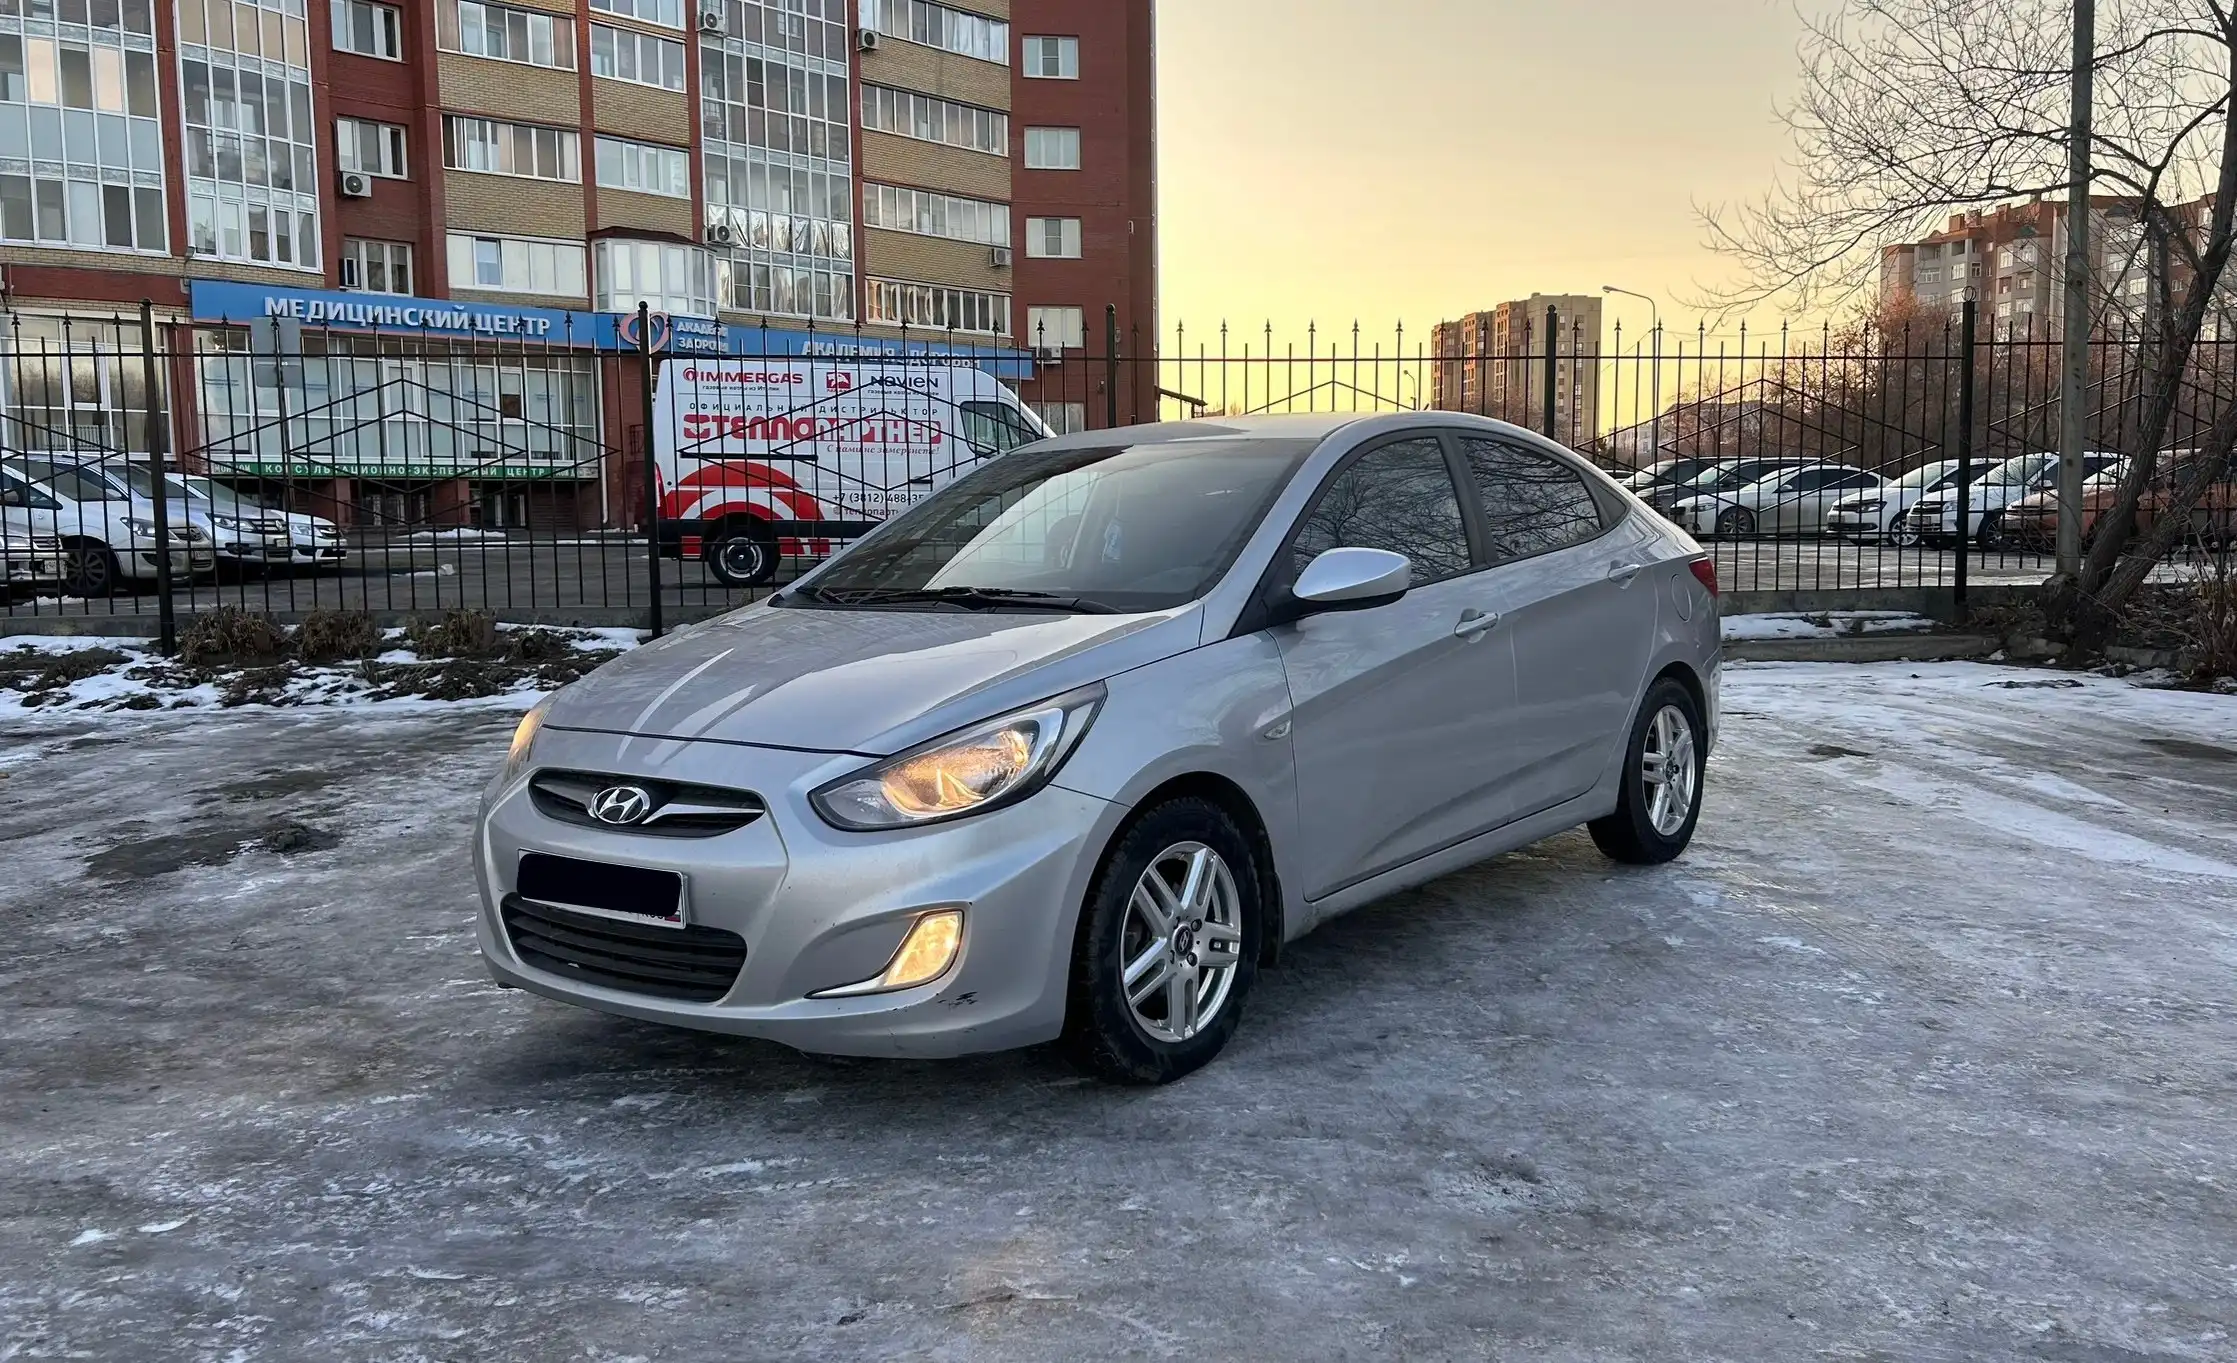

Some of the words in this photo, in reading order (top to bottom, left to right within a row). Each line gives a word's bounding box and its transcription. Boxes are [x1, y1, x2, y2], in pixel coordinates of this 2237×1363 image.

[264, 296, 470, 331] МЕДИЦИНСКИЙ
[475, 312, 551, 336] ЦЕНТР
[676, 321, 729, 337] АКАДЕ
[678, 337, 729, 352] ЗДОРО
[700, 371, 804, 384] IMMERGAS
[689, 402, 808, 413] ОФИЦИАЛЬНЫЙ
[818, 405, 939, 416] ДИСТРИЬЮТОР
[836, 445, 862, 454] ами
[877, 446, 940, 456] змернете!
[265, 464, 497, 477] КОСУЛЬТАЦИОННО-ЭКСПЕРТНЫЙ
[849, 492, 884, 504] (312)
[844, 507, 899, 517] тепопарт
